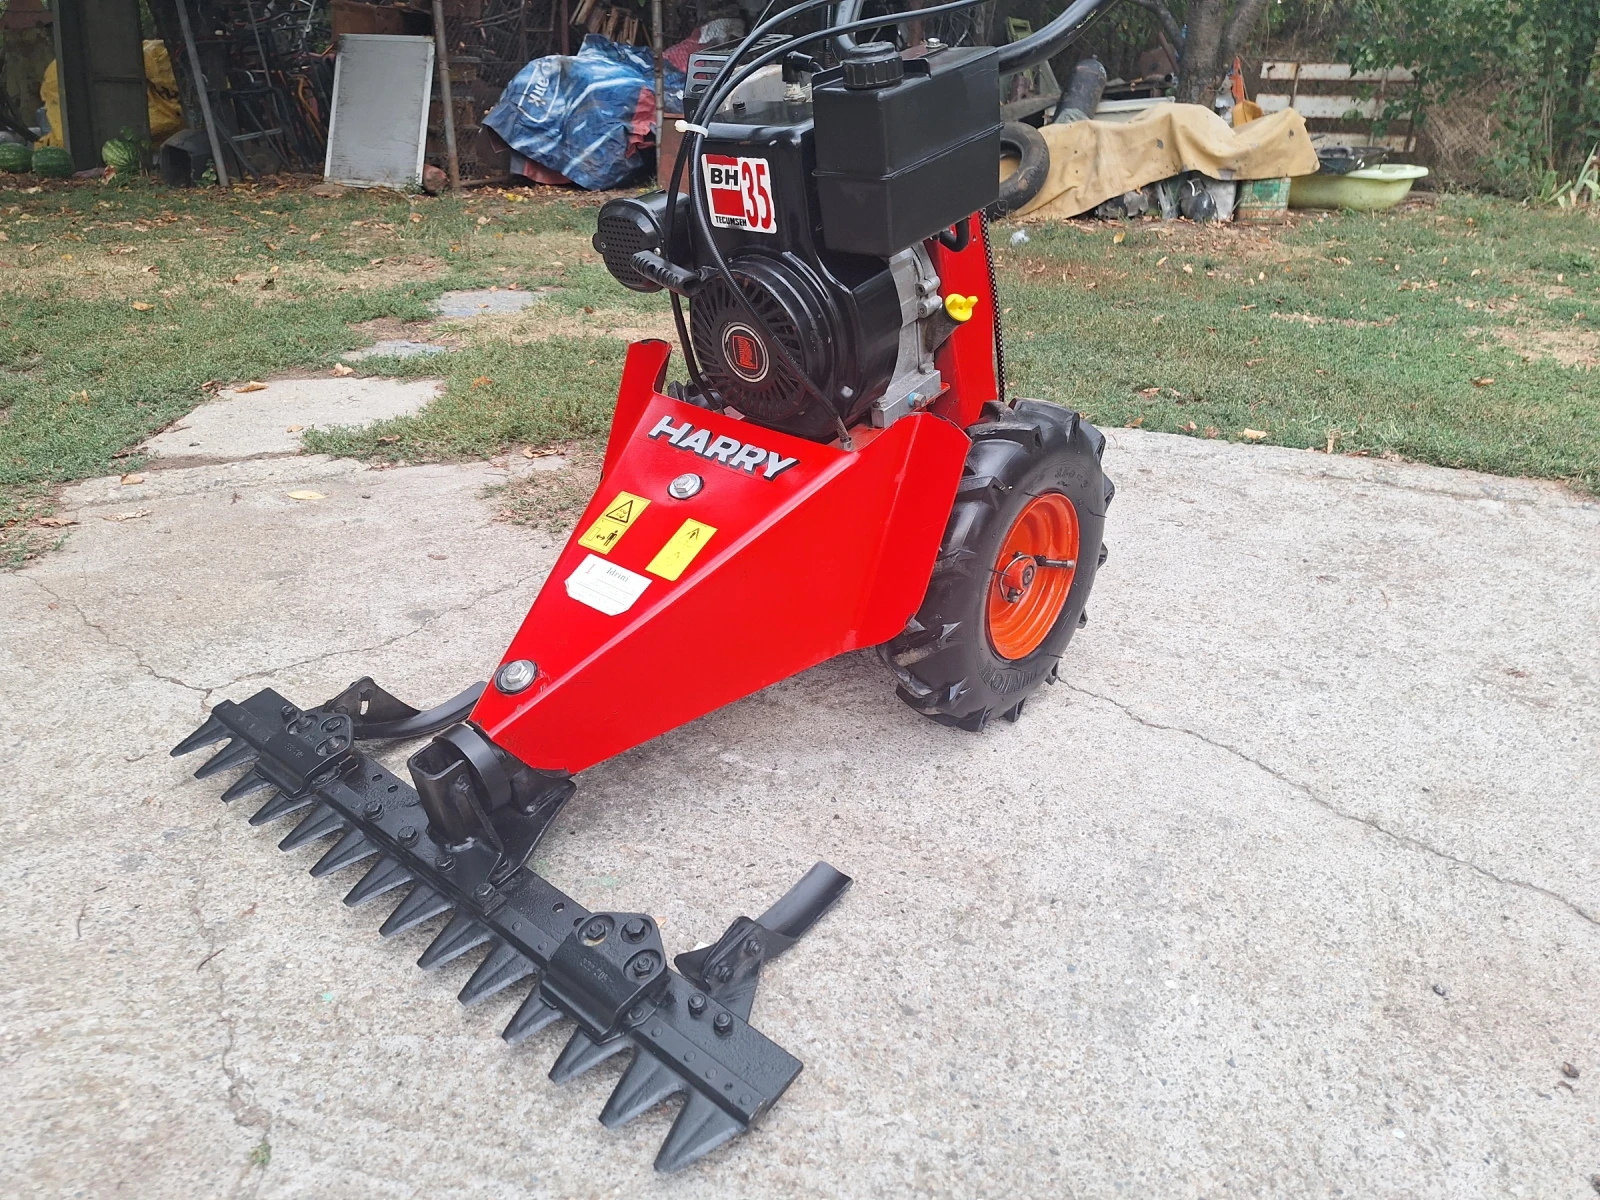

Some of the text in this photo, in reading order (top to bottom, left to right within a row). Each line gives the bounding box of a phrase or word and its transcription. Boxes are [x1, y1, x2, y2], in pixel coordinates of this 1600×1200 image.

[710, 161, 772, 230] BH 35
[715, 215, 748, 227] TECUMSEH
[648, 414, 801, 482] HARRY
